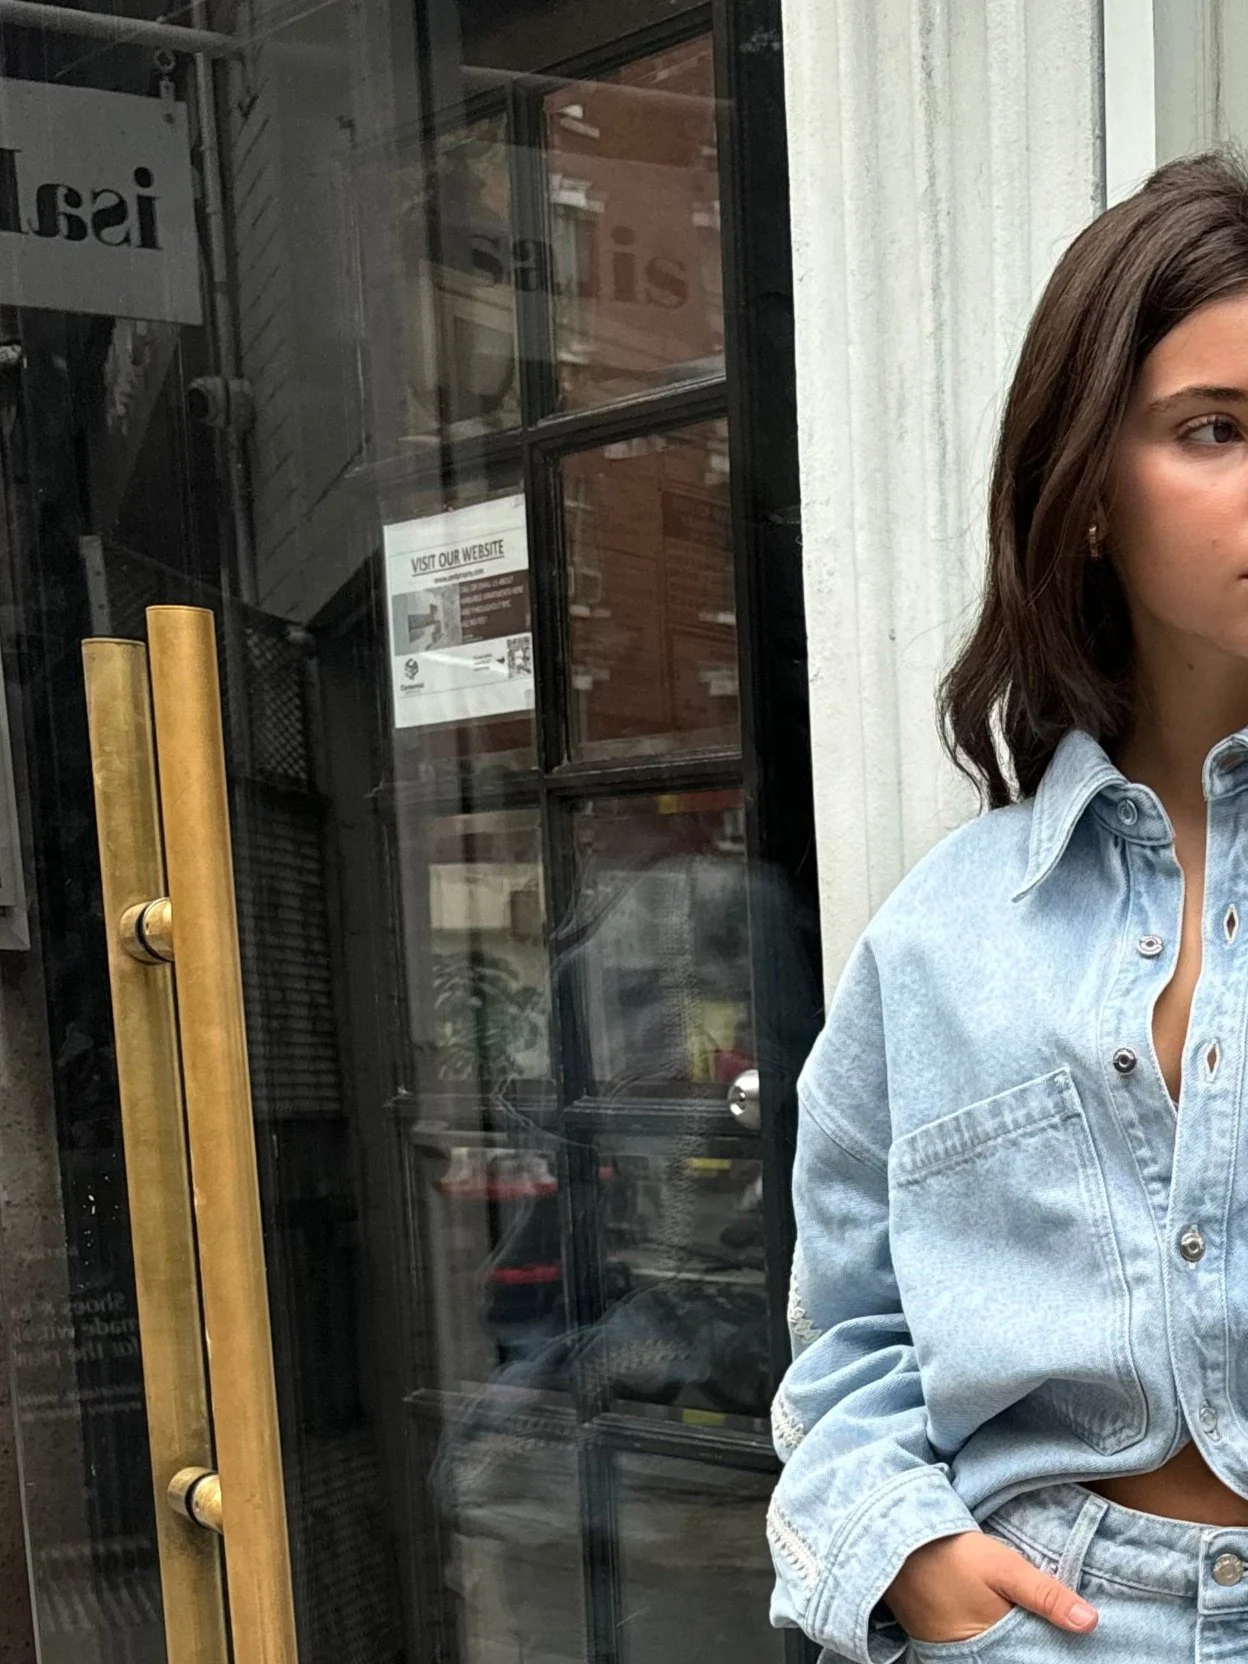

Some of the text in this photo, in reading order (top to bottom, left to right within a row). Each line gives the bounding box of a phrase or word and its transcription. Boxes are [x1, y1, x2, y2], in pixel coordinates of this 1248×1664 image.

[410, 539, 505, 573] VISIT OUR WEBSITE
